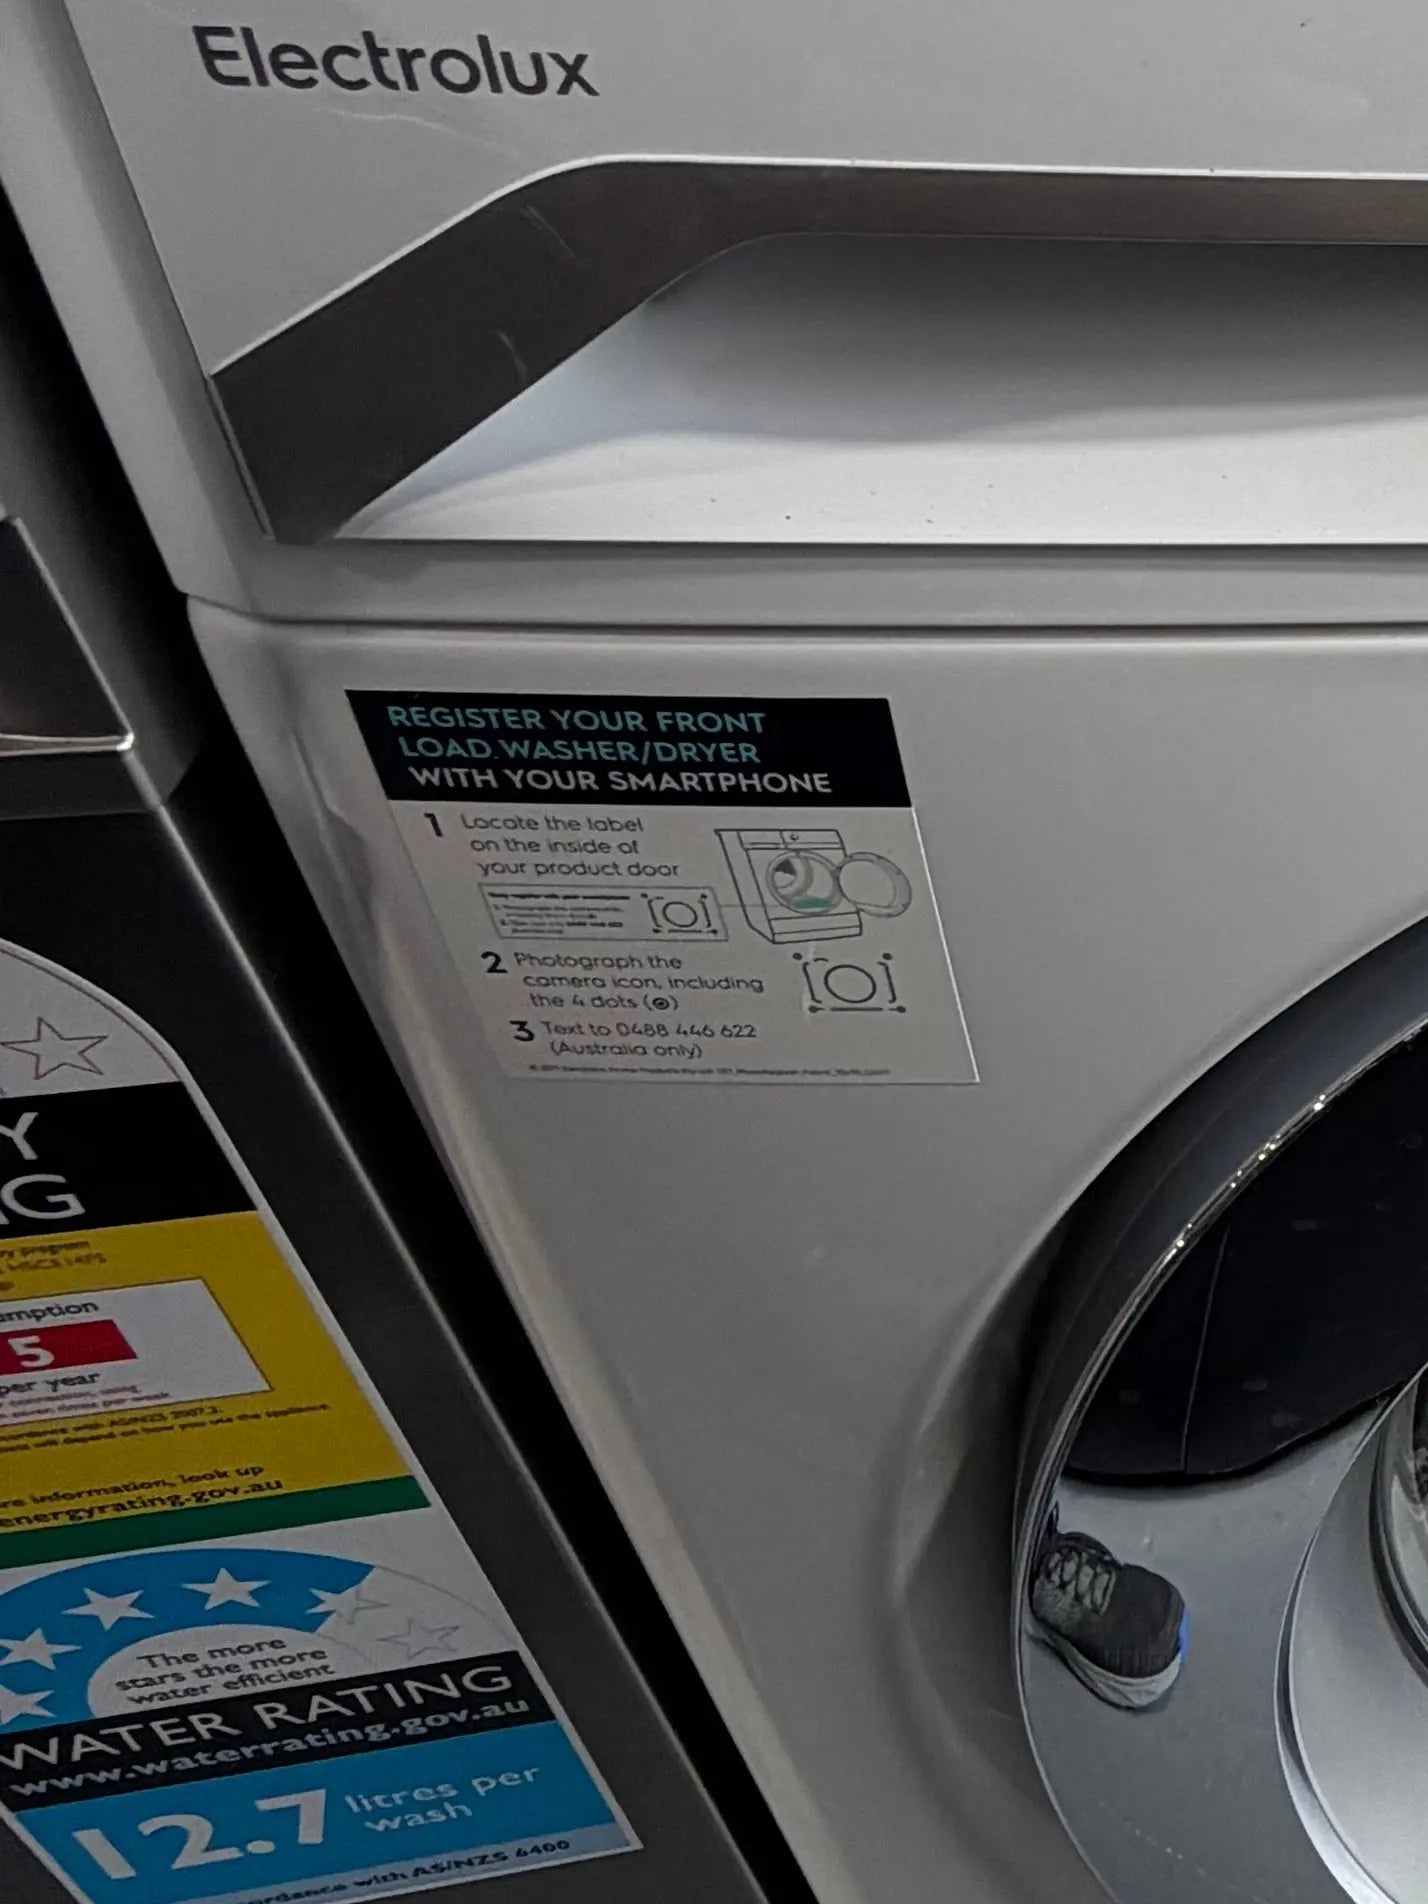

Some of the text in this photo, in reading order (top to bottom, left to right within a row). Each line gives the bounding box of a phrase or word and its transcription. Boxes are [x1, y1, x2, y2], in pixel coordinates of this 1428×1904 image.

[192, 25, 600, 96] Electrolux
[387, 705, 766, 734] REGISTER YOUR FRONT
[399, 737, 761, 765] LOAD WASHER/DRYER
[408, 767, 833, 794] WITH YOUR SMARTPHONE
[424, 812, 644, 837] 1 Locate the label
[469, 838, 641, 854] on the inside of
[476, 861, 680, 877] your product door
[480, 950, 682, 974] 2 Photograph the
[523, 974, 607, 989] camera
[668, 975, 764, 994] including
[529, 991, 638, 1009] the 4 dots
[509, 1020, 757, 1042] 3 Text to 0488 446 622
[550, 1041, 703, 1060] (Australia only)
[42, 1371, 101, 1393] year
[179, 1469, 230, 1485] look
[235, 1465, 264, 1482] up
[136, 1638, 287, 1669] The more
[115, 1649, 328, 1692] stars the more
[126, 1663, 336, 1705] water efficient
[0, 1664, 512, 1771] WATER RATING
[9, 1697, 530, 1797] www.waterrating.gov.au
[343, 1766, 540, 1814] litres per
[363, 1802, 473, 1834] wash
[72, 1788, 327, 1880] 12.7
[353, 1869, 408, 1889] with
